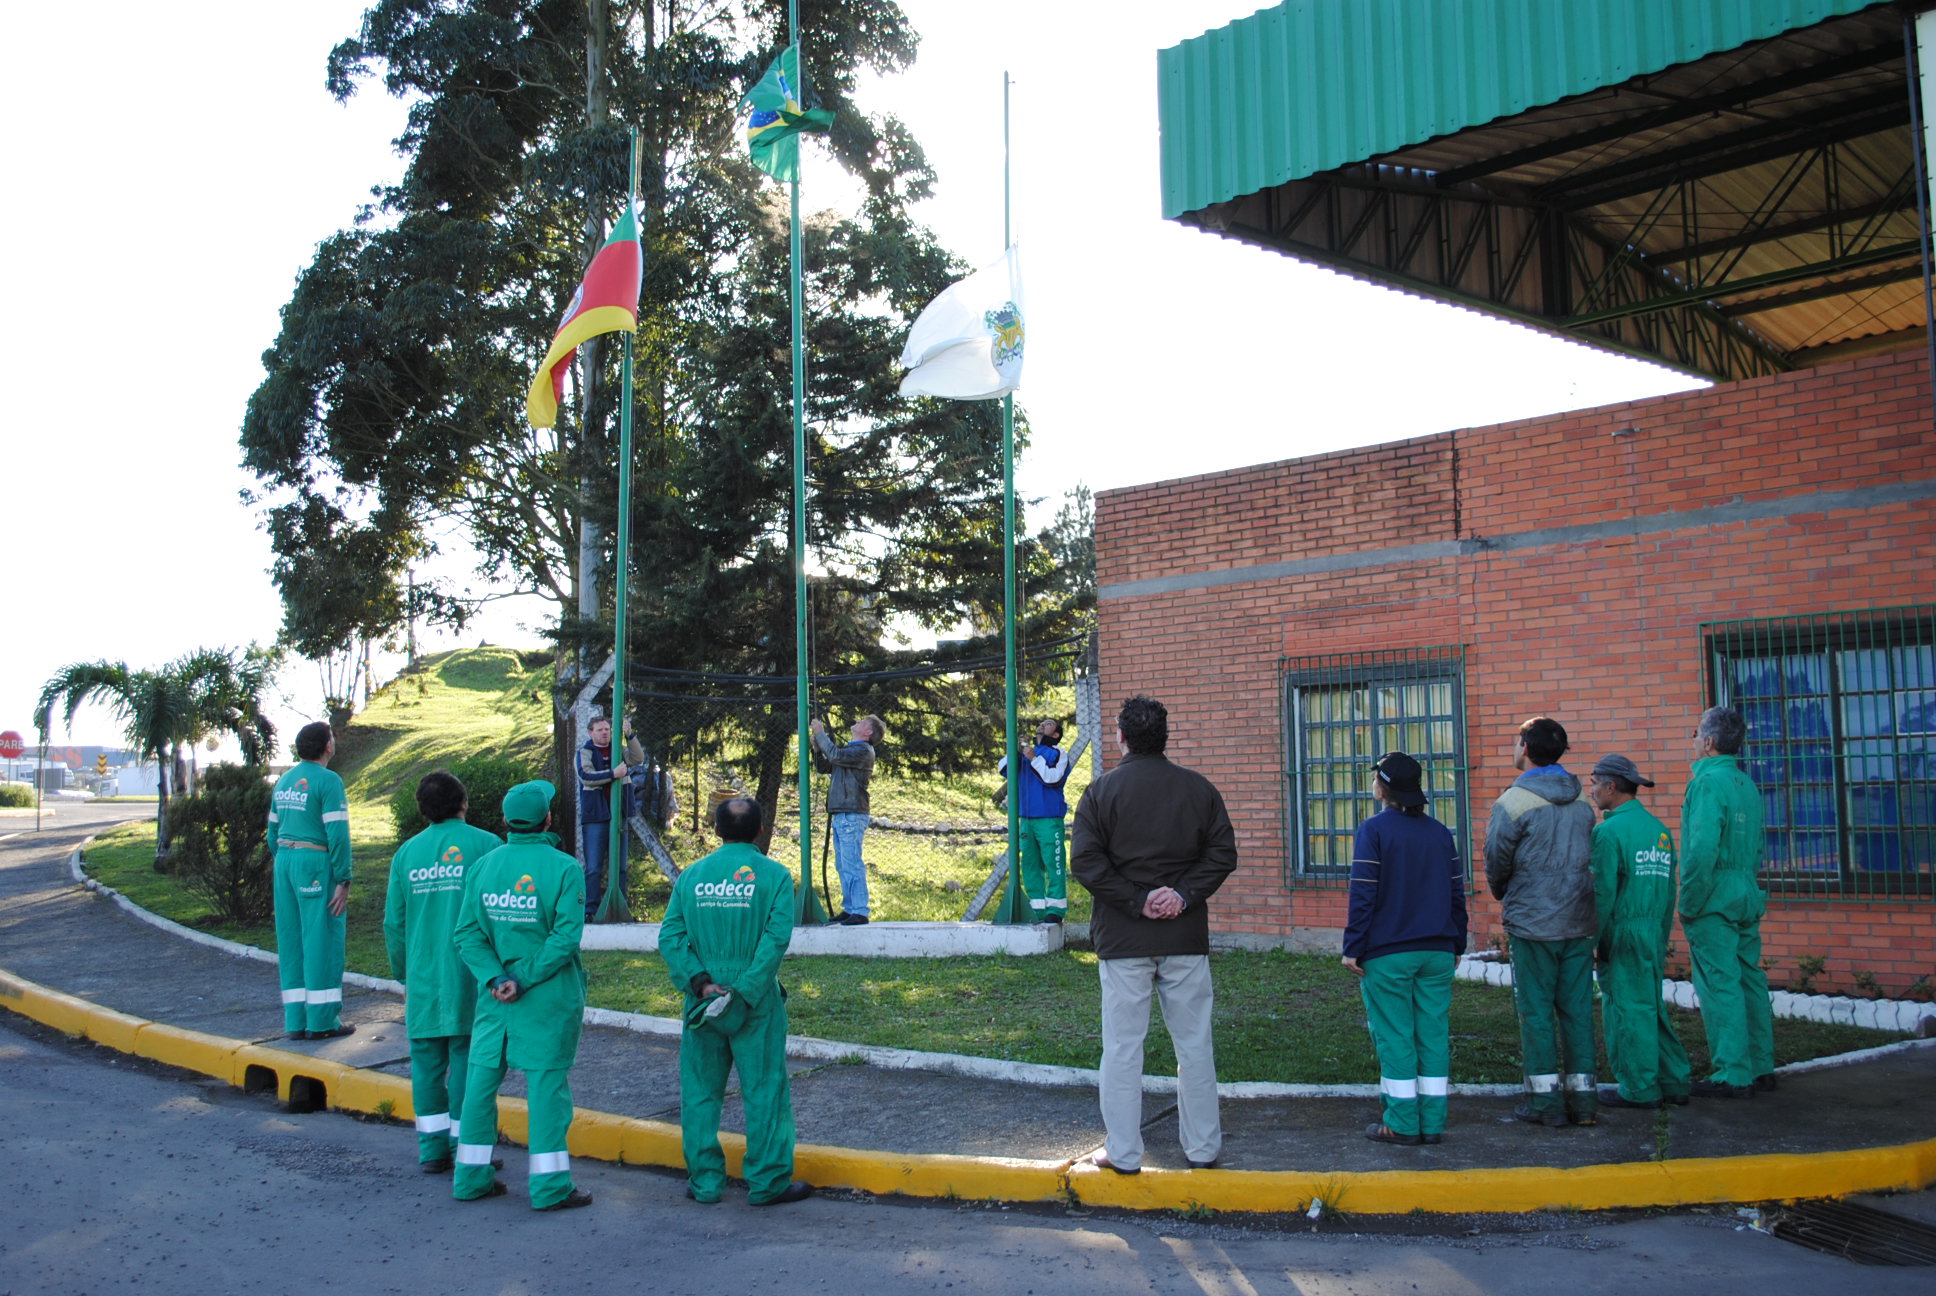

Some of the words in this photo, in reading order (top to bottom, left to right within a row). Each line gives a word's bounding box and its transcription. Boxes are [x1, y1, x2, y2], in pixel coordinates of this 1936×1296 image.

[0, 739, 24, 750] PARE
[274, 787, 308, 802] codeca
[409, 861, 464, 881] codeca
[694, 878, 756, 897] codeca
[482, 888, 537, 909] codeca
